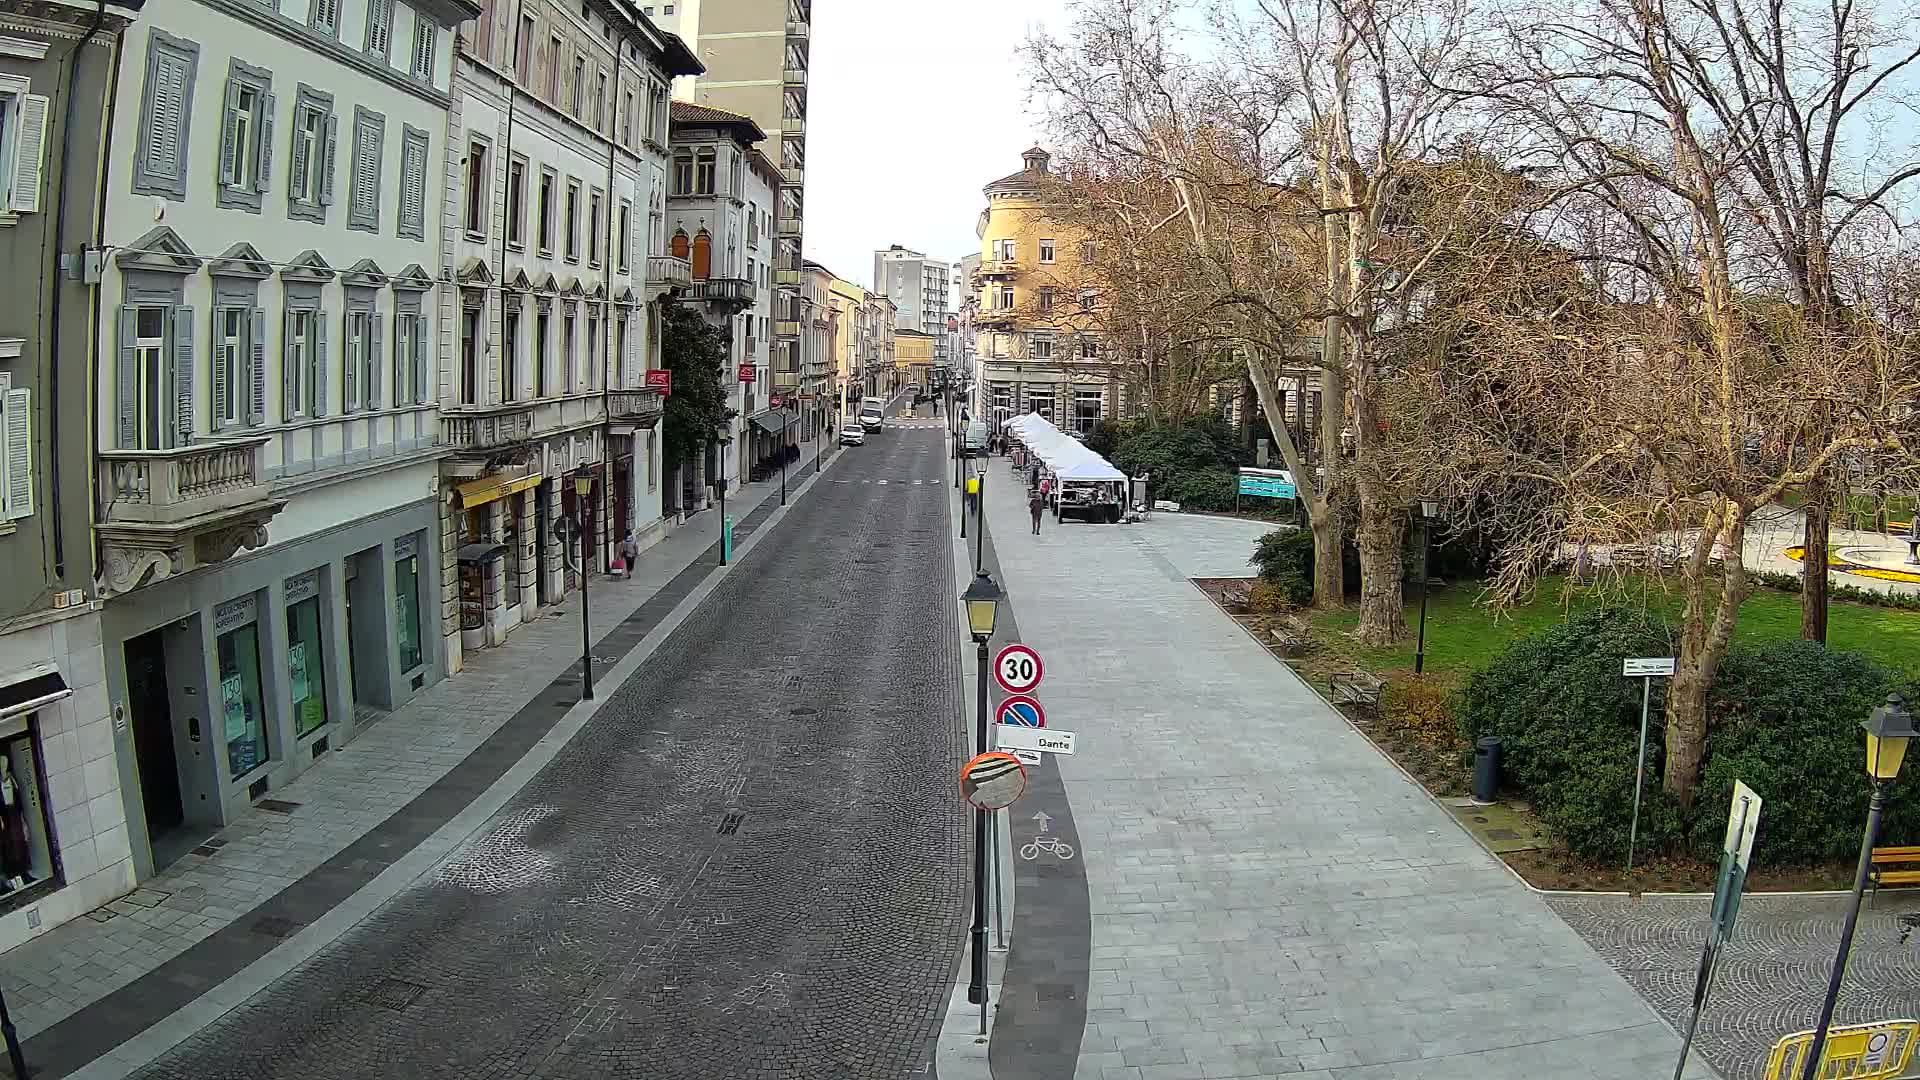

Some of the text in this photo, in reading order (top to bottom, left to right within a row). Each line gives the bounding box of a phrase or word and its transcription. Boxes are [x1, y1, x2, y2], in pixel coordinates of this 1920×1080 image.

[1005, 659, 1032, 680] 30
[222, 678, 240, 701] 130
[1038, 738, 1070, 750] Dante
